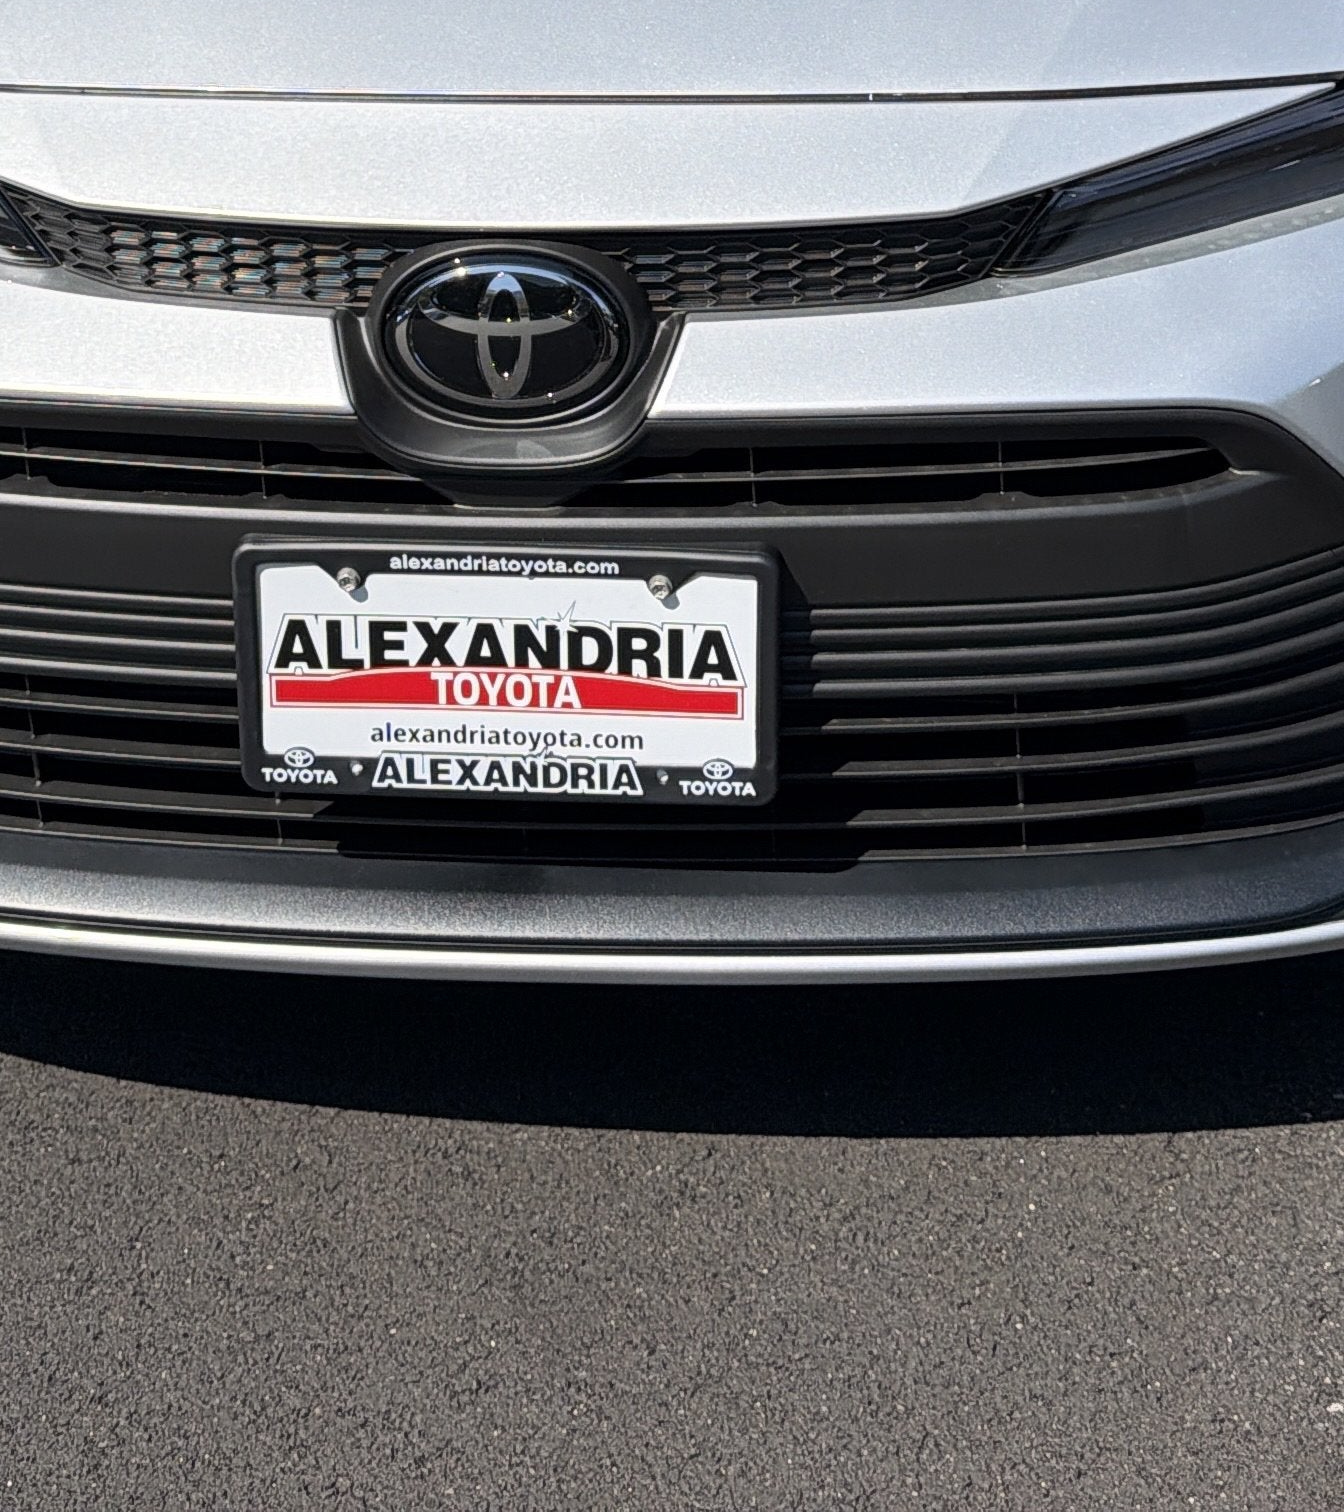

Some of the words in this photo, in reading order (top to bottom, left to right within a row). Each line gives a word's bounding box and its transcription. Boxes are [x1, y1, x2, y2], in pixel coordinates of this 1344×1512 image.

[389, 554, 619, 575] alexandriatoyota.com
[272, 618, 739, 682] ALEXANDRIA
[430, 671, 582, 709] TOYOTA
[370, 723, 644, 751] alexandriatoyota.com
[261, 768, 338, 785] TOYOTA
[373, 754, 642, 794] ALEXANDRIA
[679, 779, 757, 797] TOYOTA
